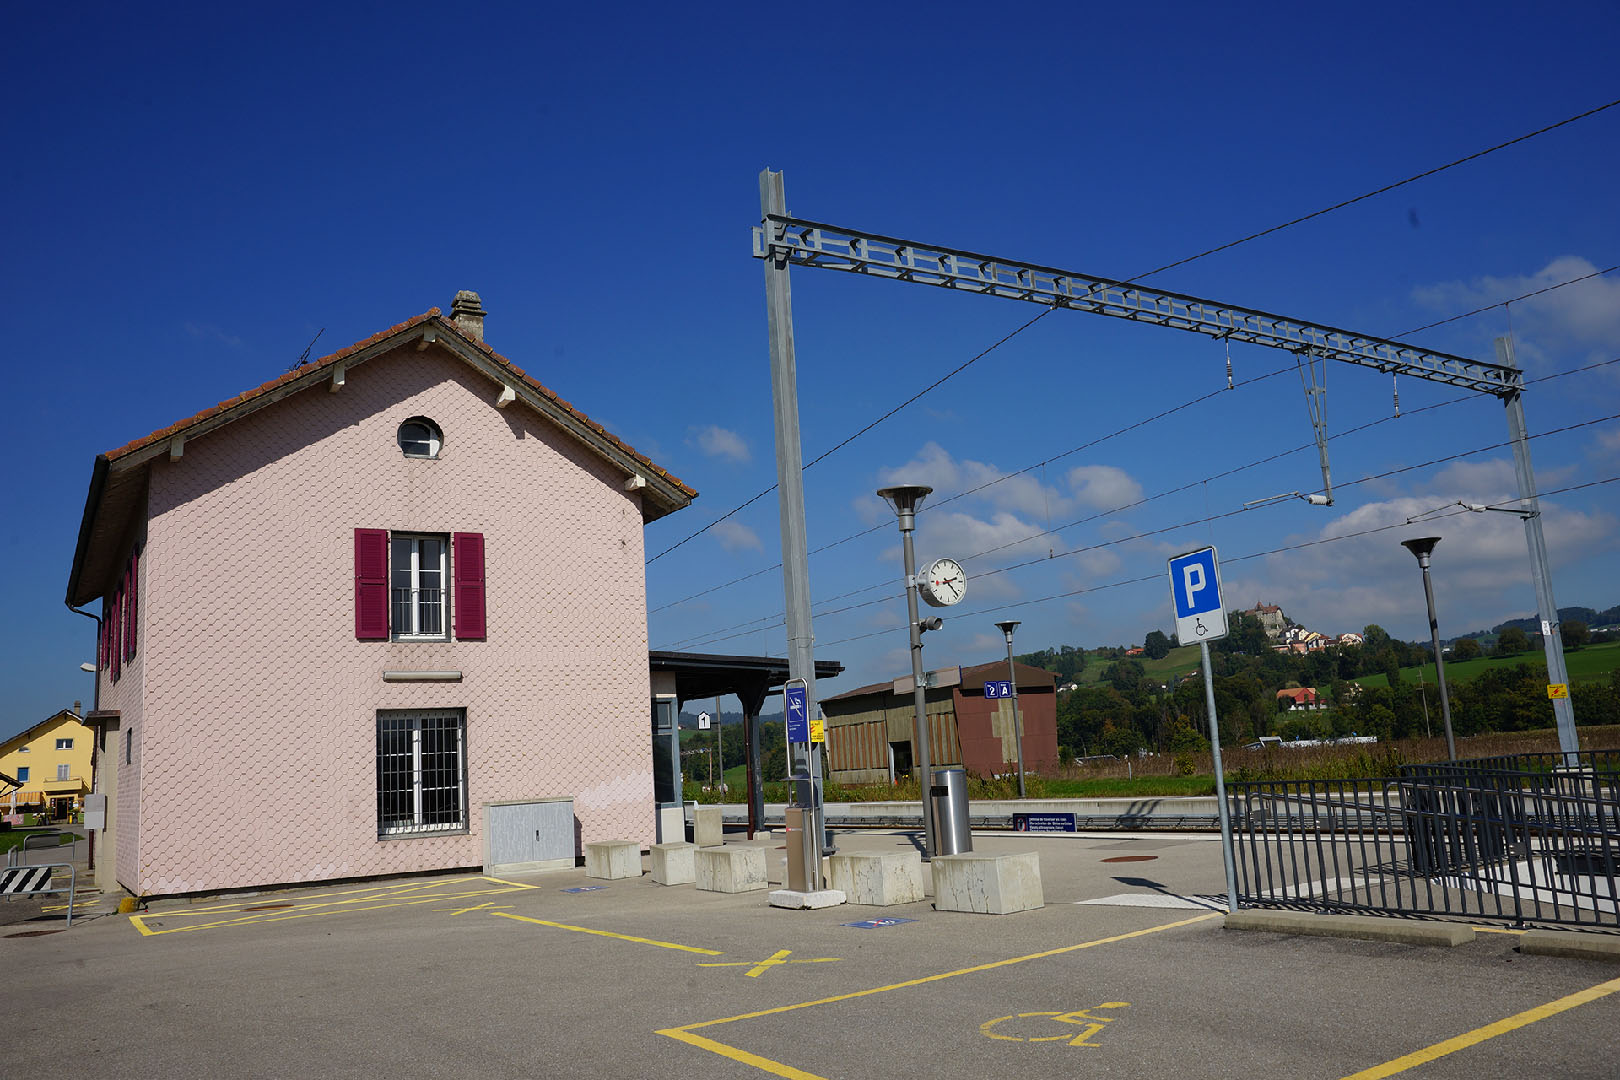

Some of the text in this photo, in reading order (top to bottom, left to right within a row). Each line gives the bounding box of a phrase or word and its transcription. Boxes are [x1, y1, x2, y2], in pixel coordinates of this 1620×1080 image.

[1183, 562, 1207, 609] P
[990, 686, 996, 695] 2
[1002, 686, 1008, 695] A
[701, 716, 706, 728] 1
